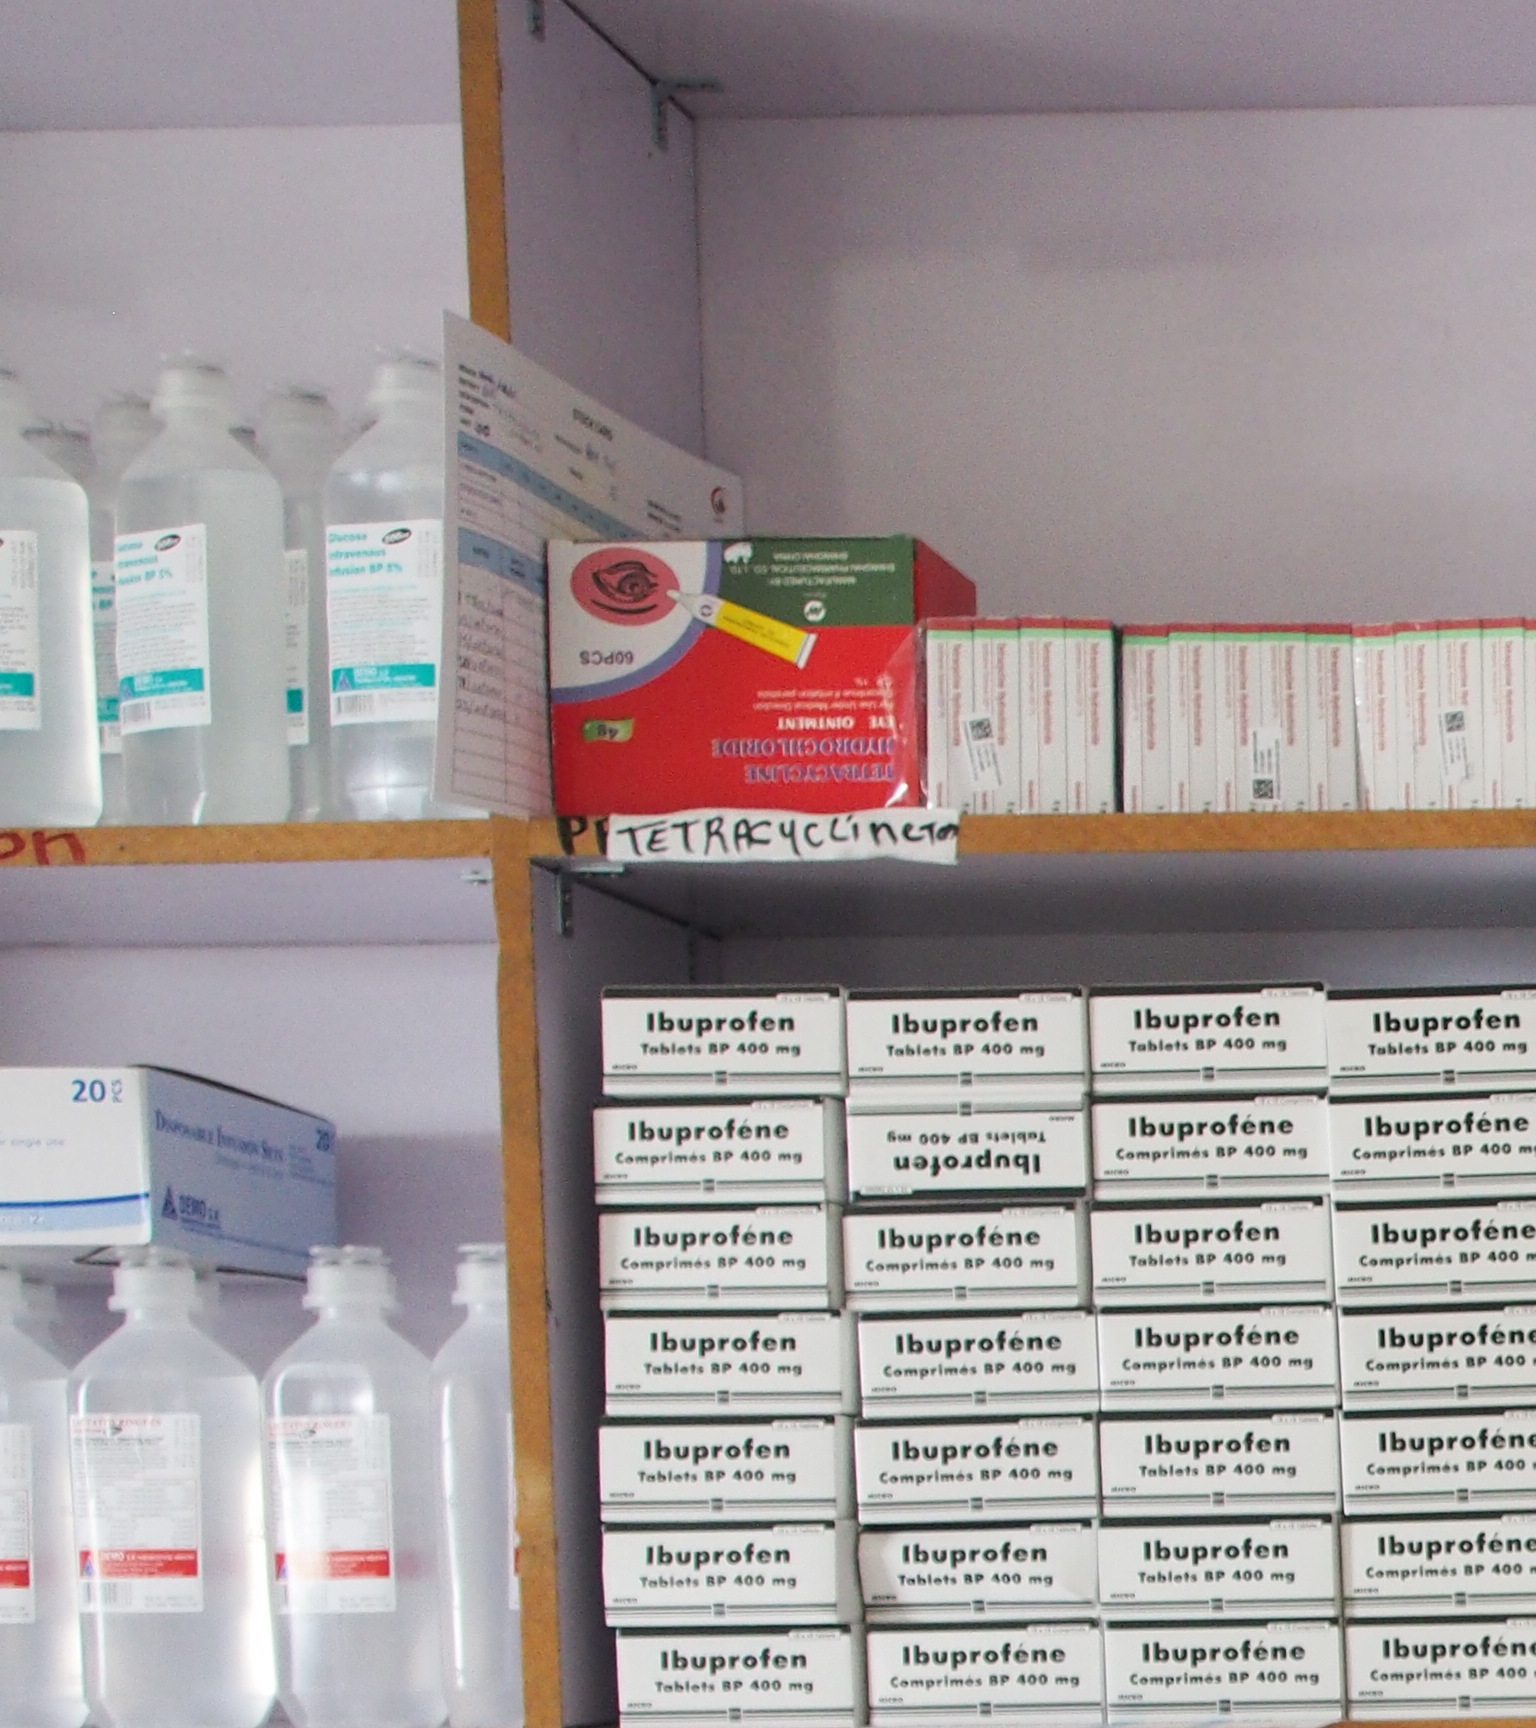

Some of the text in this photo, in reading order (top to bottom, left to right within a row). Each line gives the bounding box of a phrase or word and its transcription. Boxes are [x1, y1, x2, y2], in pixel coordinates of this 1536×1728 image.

[580, 650, 634, 664] 60PCS
[777, 717, 855, 729] OINTMENT
[712, 740, 894, 755] HYDROCHLORIDE
[745, 764, 894, 781] TETRACYCLINE
[646, 1011, 795, 1037] Ibuprofen
[891, 1013, 1039, 1039] Ibuprofen
[1372, 1008, 1520, 1035] Ibuprofen
[641, 1042, 801, 1058] Tablets BP 400 mg
[72, 1080, 106, 1102] 20
[627, 1118, 789, 1145] Ibuproféne
[615, 1149, 802, 1166] Comprimés BP 400 mg
[1371, 1219, 1536, 1248] Ibuproféne
[895, 1328, 1062, 1358] Ibuproféne
[660, 1649, 807, 1675] Ibuprofen
